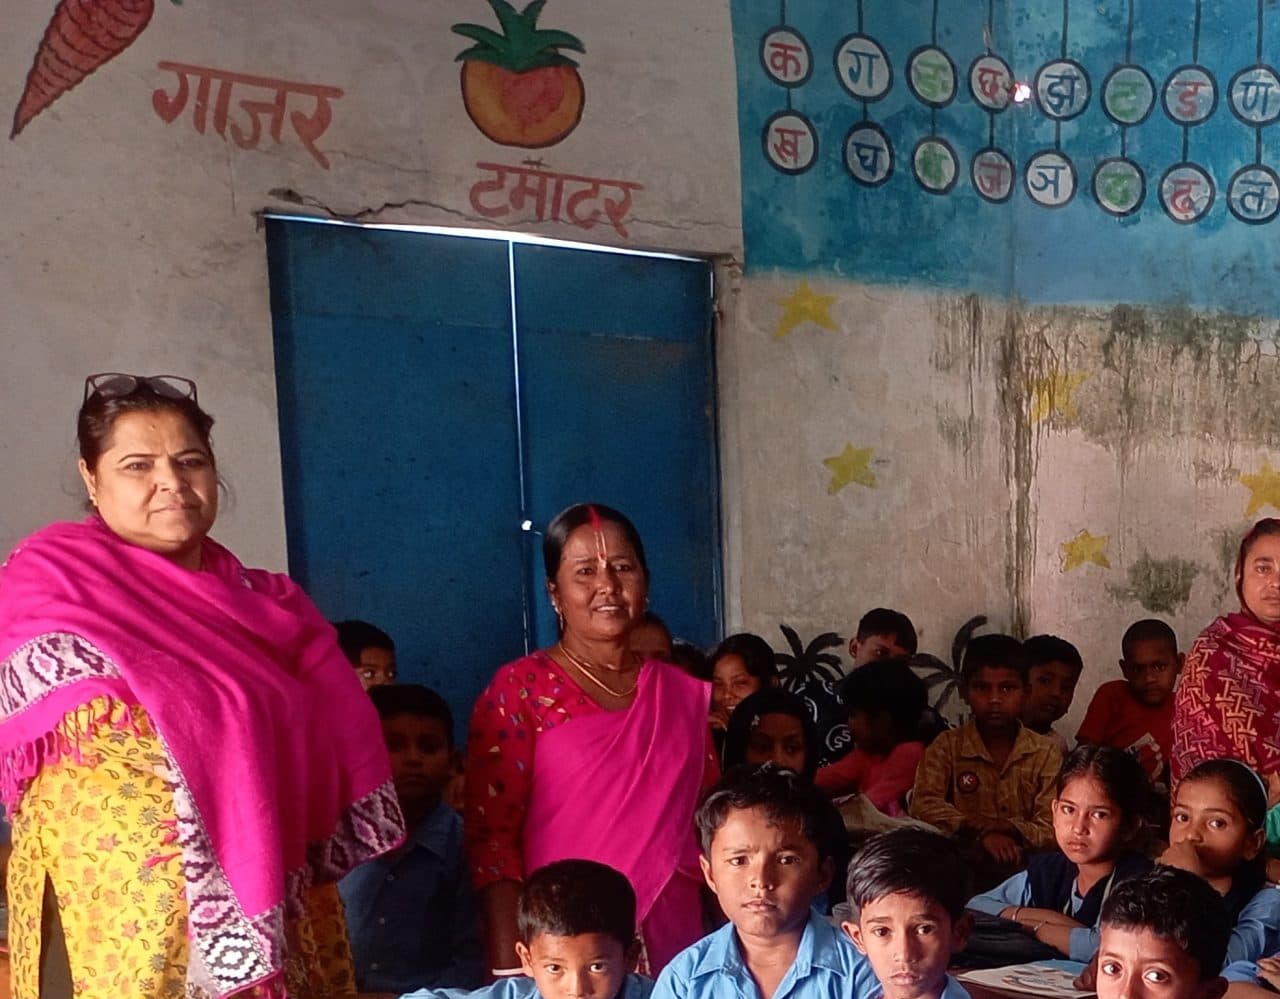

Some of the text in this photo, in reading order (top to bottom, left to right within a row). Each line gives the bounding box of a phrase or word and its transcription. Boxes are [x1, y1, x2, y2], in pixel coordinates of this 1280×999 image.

[770, 42, 803, 78] क
[847, 50, 880, 89] ग
[152, 61, 345, 170] गाजर
[773, 127, 806, 166] ख
[469, 161, 644, 239] टमाटर
